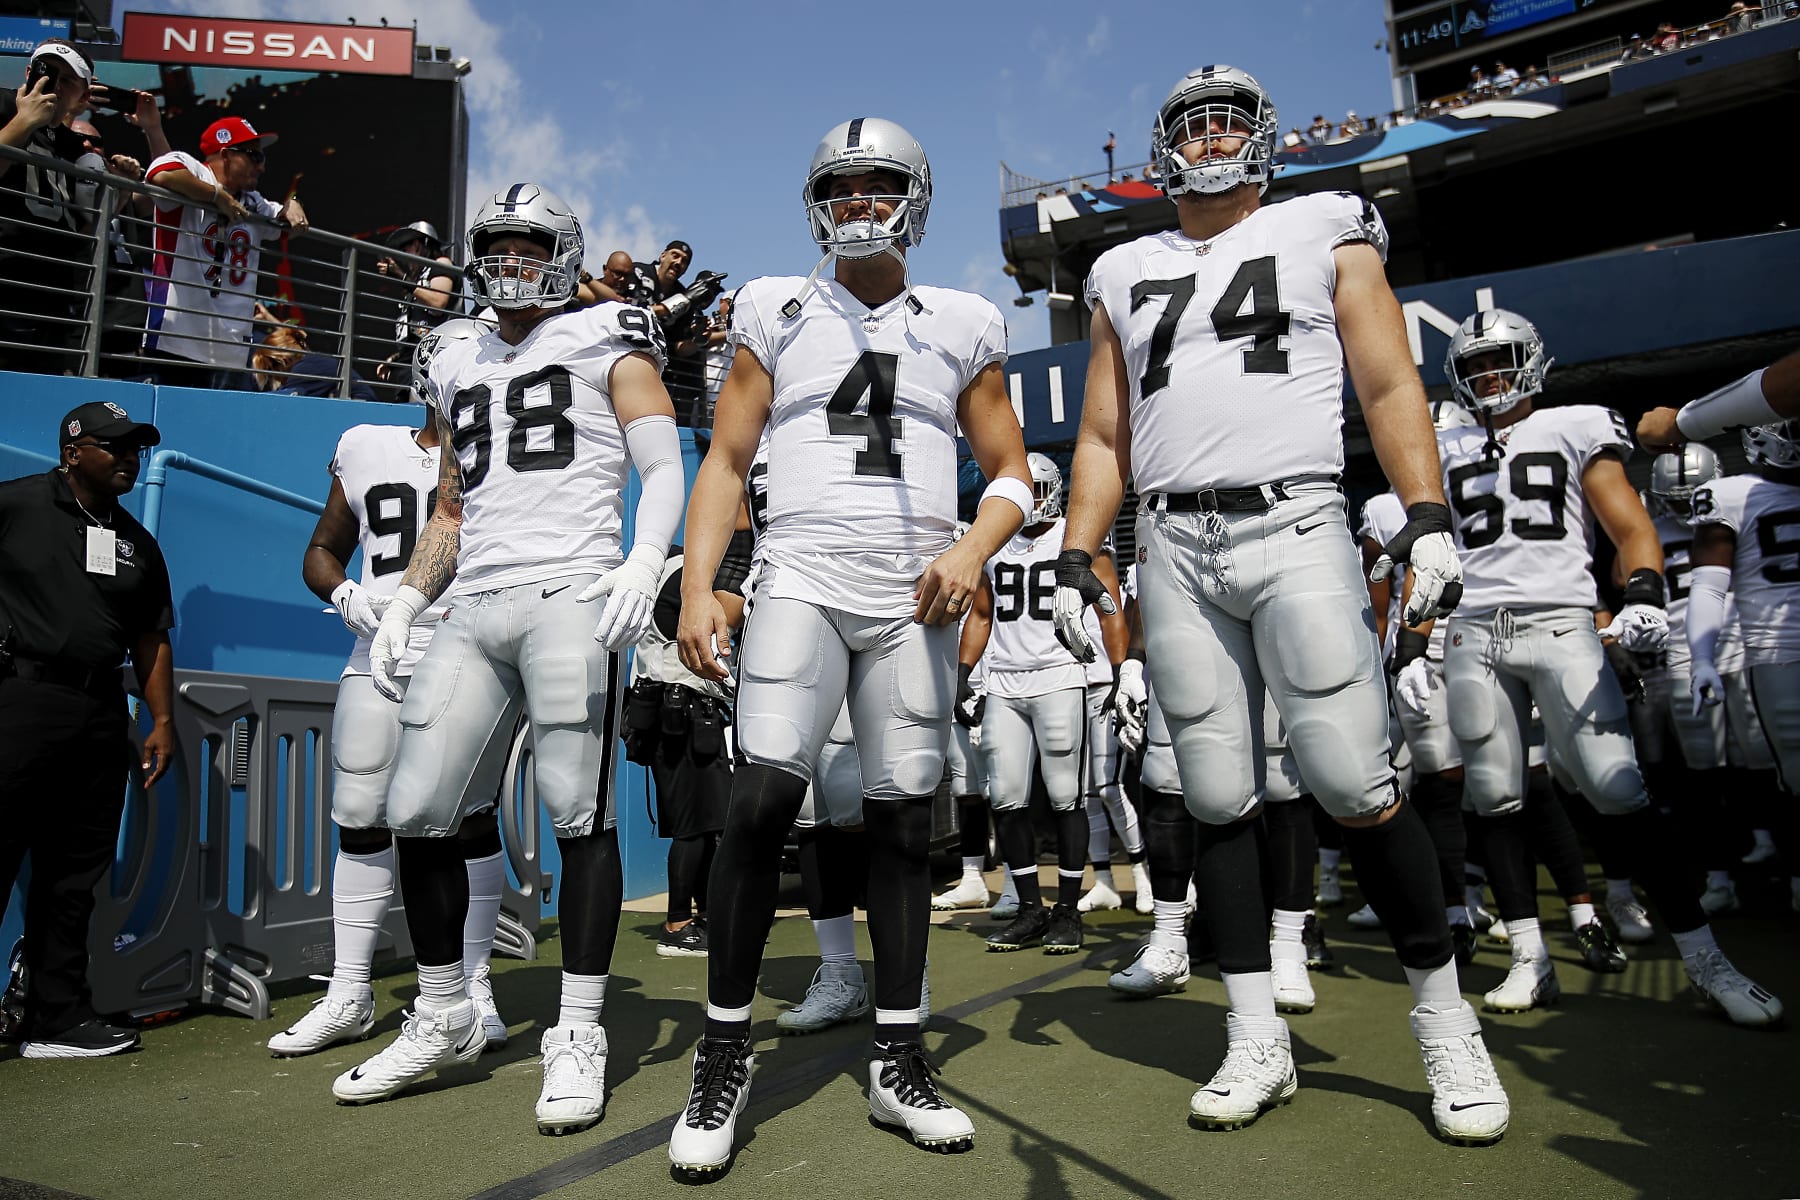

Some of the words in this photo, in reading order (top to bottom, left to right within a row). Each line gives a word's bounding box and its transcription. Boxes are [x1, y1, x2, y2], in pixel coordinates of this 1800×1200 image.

[163, 27, 375, 62] NISSAN
[1401, 19, 1452, 49] 11:49
[1129, 254, 1292, 401] 74
[449, 363, 576, 496] 98
[824, 350, 905, 480] 4
[1447, 451, 1569, 550] 59
